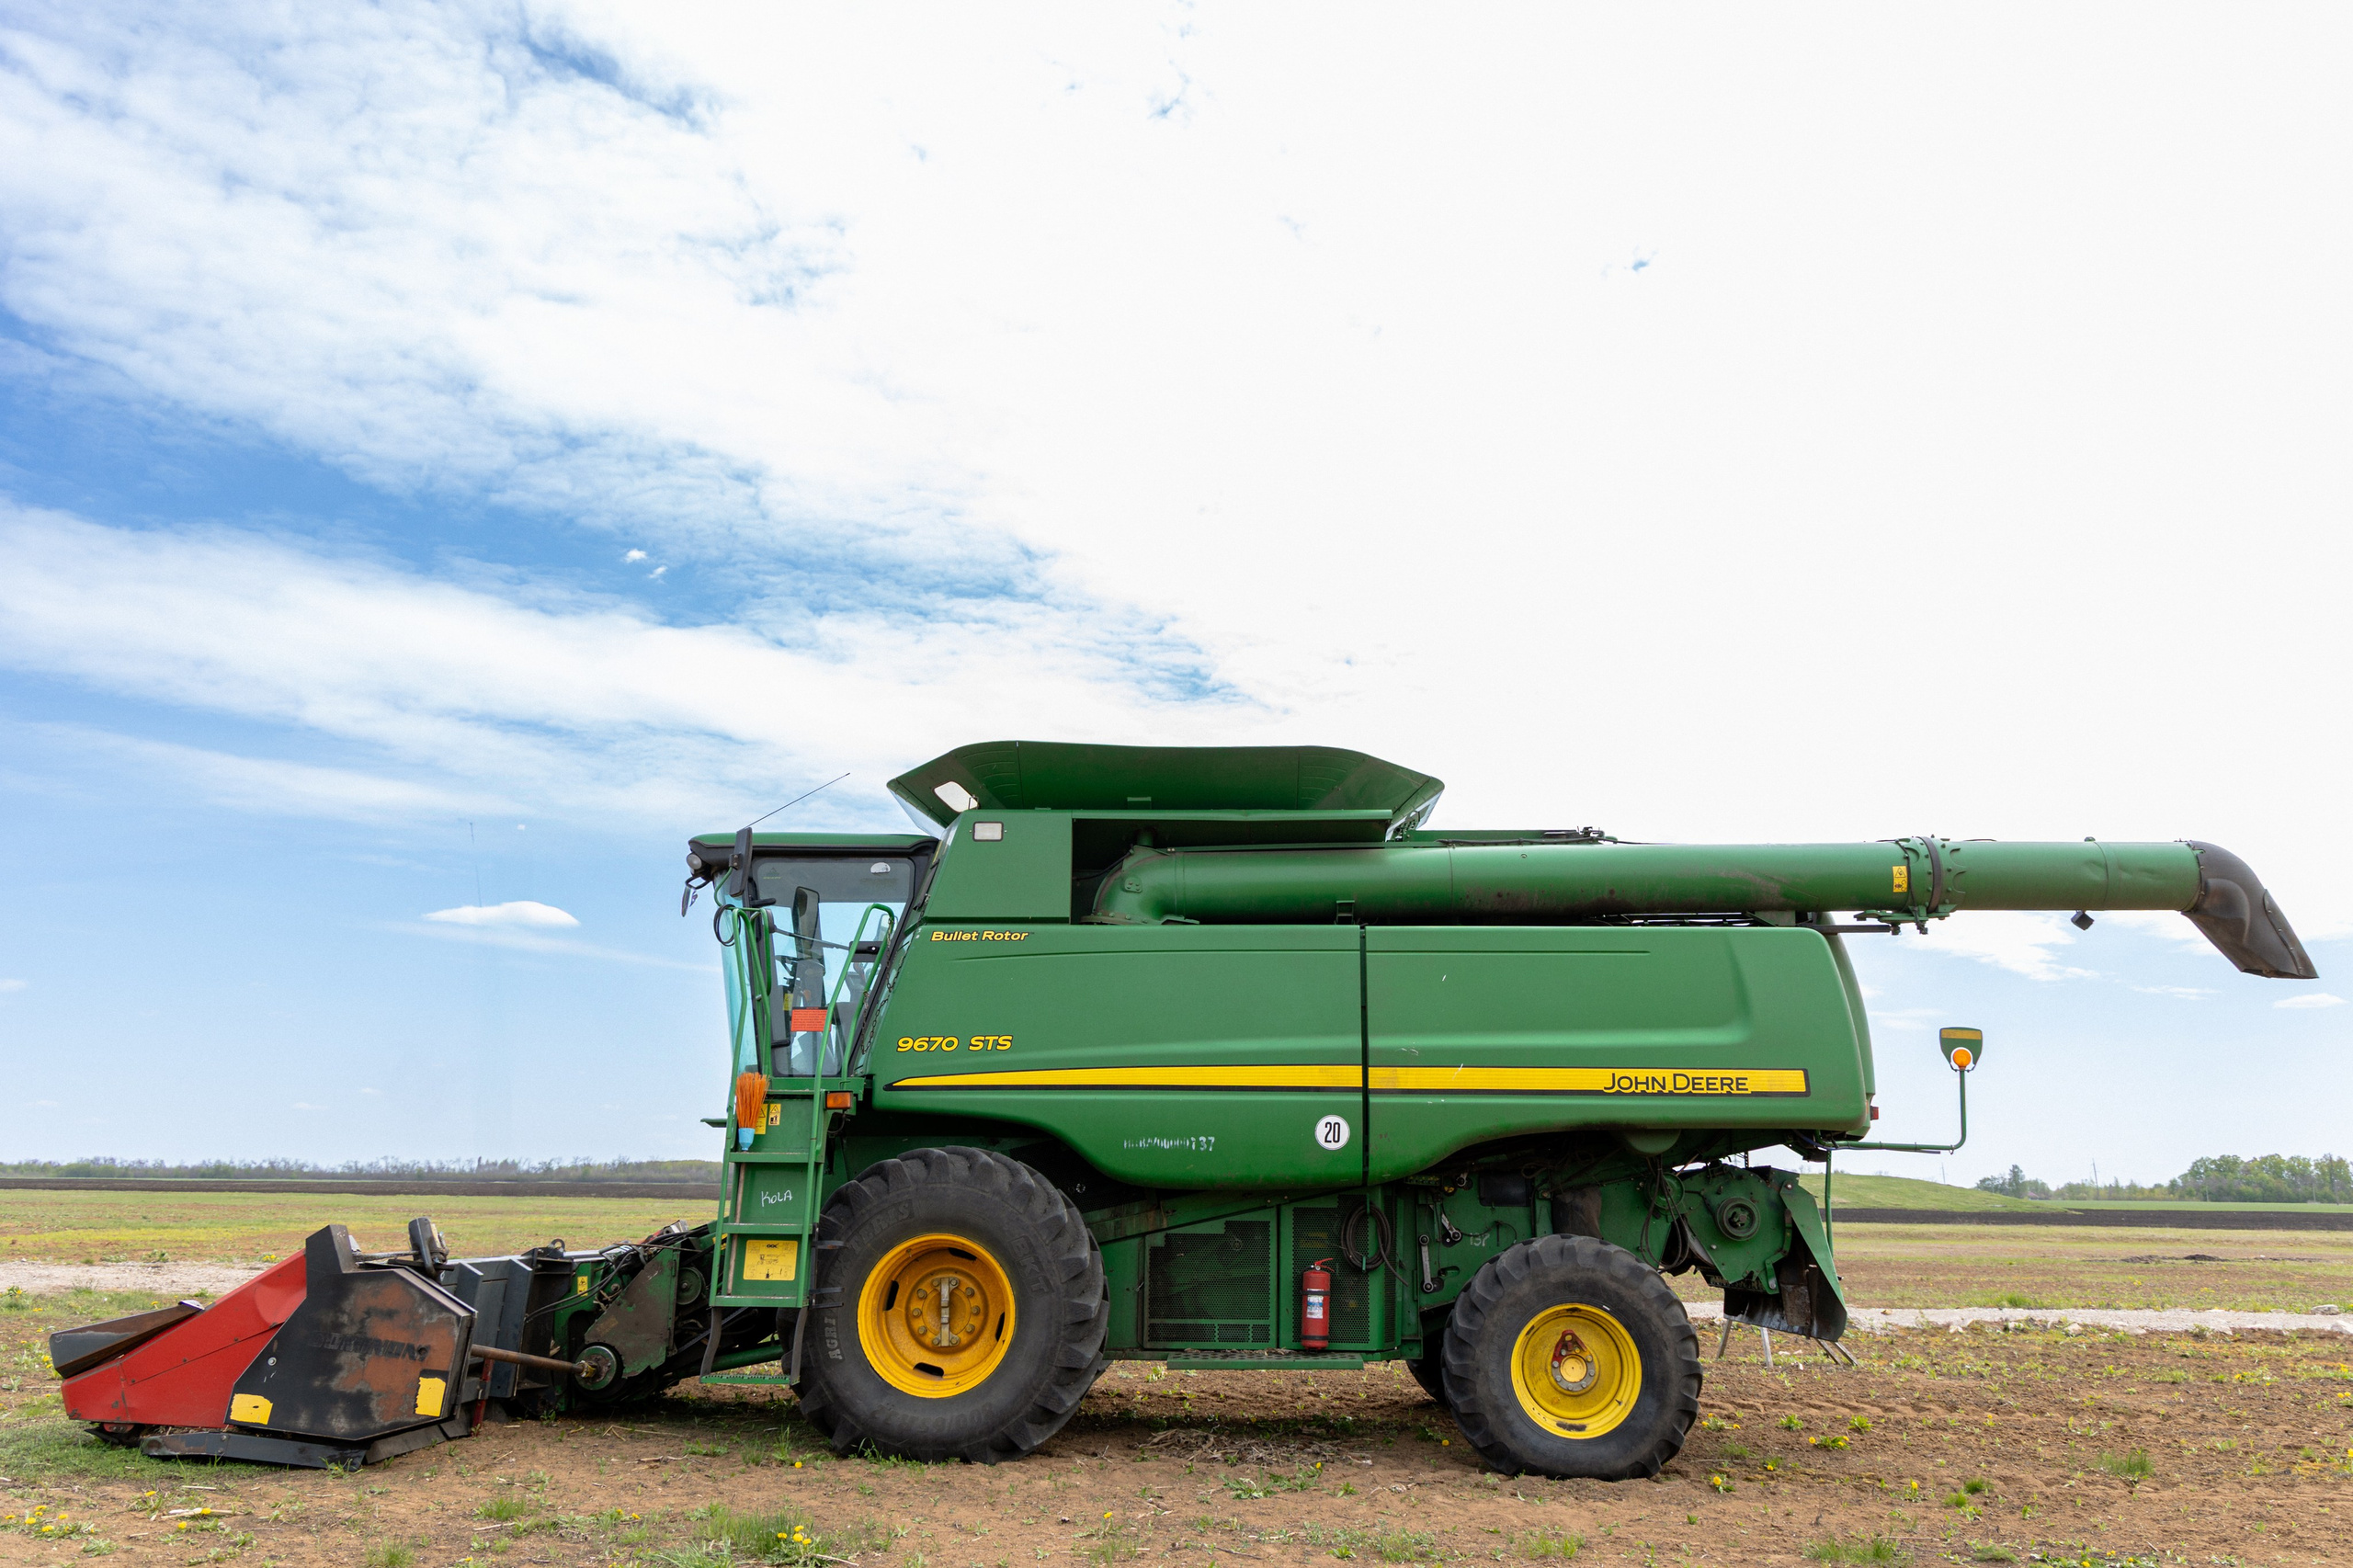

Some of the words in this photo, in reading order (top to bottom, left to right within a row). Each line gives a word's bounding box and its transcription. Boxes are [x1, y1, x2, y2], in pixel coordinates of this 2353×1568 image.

[930, 929, 979, 941] Bullet
[982, 929, 1029, 941] Rotor
[896, 1036, 960, 1052] 9670
[968, 1035, 1013, 1051] STS
[1603, 1073, 1666, 1092] JOHN
[1673, 1073, 1749, 1092] DEERE
[1324, 1121, 1341, 1143] 20
[1012, 1237, 1048, 1291] BKT
